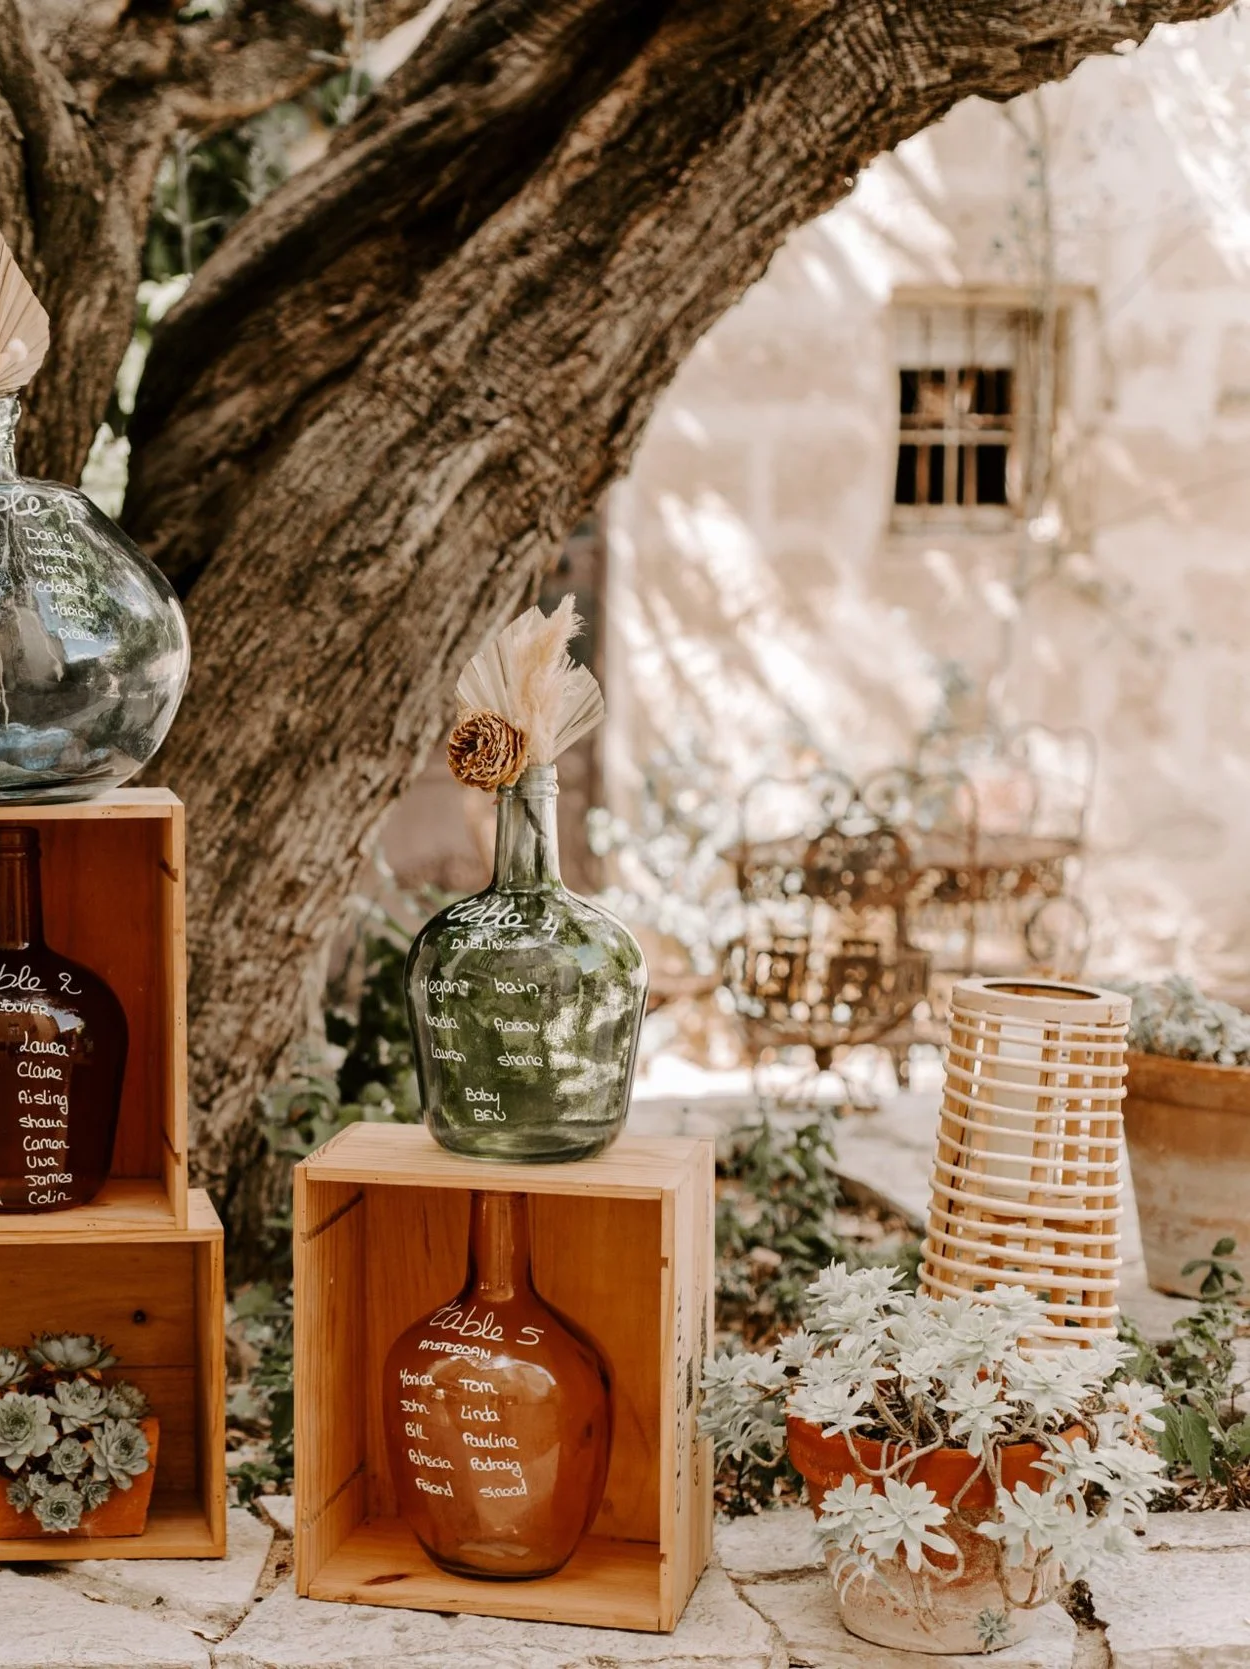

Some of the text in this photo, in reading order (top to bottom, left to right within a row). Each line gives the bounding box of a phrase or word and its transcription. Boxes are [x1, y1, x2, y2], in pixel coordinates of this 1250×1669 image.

[22, 527, 76, 543] Daniel
[34, 561, 71, 575] Mam
[36, 579, 86, 597] Colette
[49, 602, 94, 618] Marion
[58, 625, 98, 643] Diane
[447, 897, 560, 941] table 4
[450, 938, 503, 951] DUBLIN
[58, 972, 82, 994] 2
[420, 975, 462, 1003] Megan
[425, 1012, 460, 1030] Nadia
[493, 1017, 540, 1032] Aaron
[19, 1030, 70, 1057] Laura
[431, 1043, 466, 1063] Lauren
[17, 1060, 63, 1080] Claire
[18, 1089, 68, 1115] Aisling
[465, 1087, 500, 1110] Baby
[474, 1108, 507, 1121] BEN
[24, 1173, 73, 1187] James
[28, 1190, 72, 1205] Colin
[429, 1299, 545, 1346] table 5
[399, 1368, 436, 1388] Monica
[458, 1378, 499, 1394] Tom
[400, 1399, 430, 1415] John
[461, 1404, 500, 1422] Linda
[405, 1421, 429, 1440] Bill
[462, 1431, 519, 1449] Pauline
[408, 1448, 455, 1470] Patricia
[470, 1456, 522, 1478] Padraig
